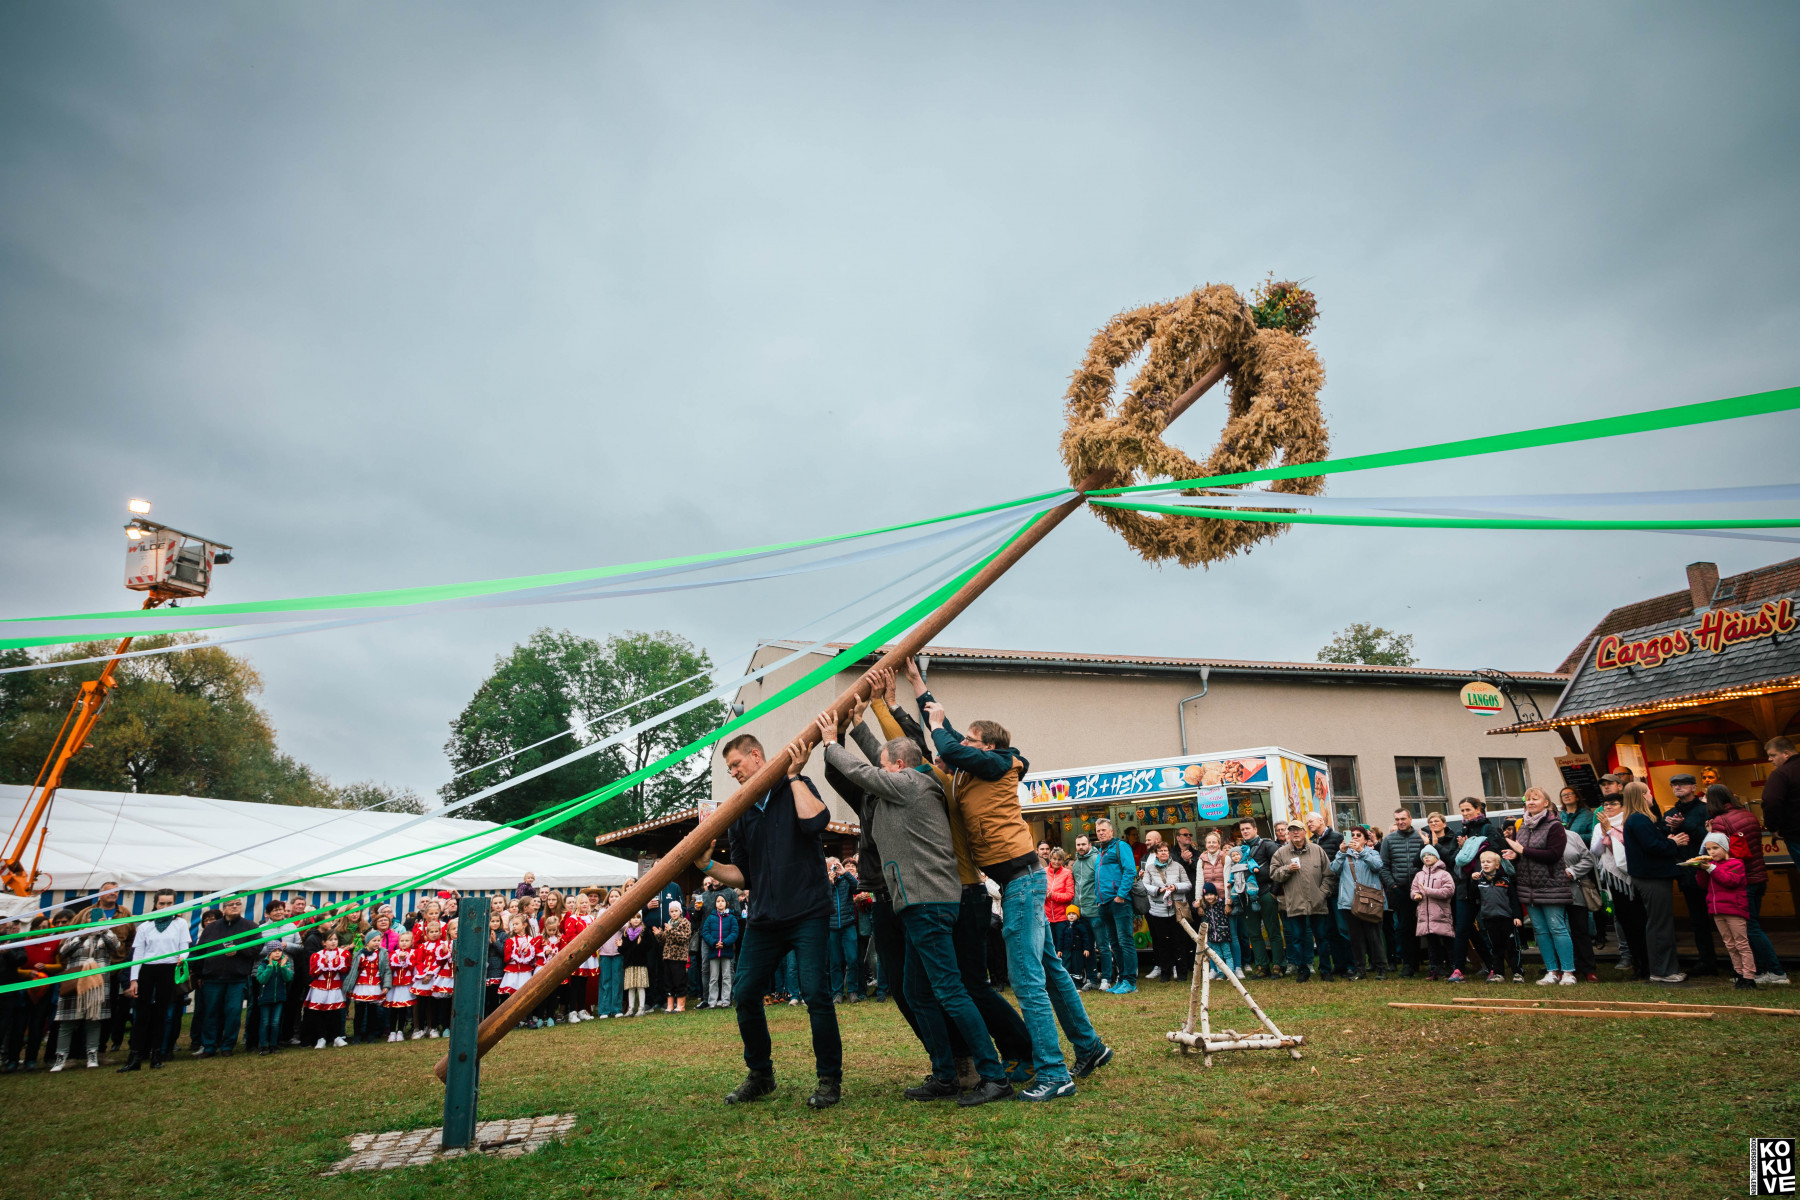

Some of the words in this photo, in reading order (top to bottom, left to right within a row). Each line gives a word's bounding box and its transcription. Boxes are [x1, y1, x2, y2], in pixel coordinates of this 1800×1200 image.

[128, 541, 165, 553] WILDE
[1597, 630, 1688, 669] Langos
[1467, 692, 1500, 707] LANGOS
